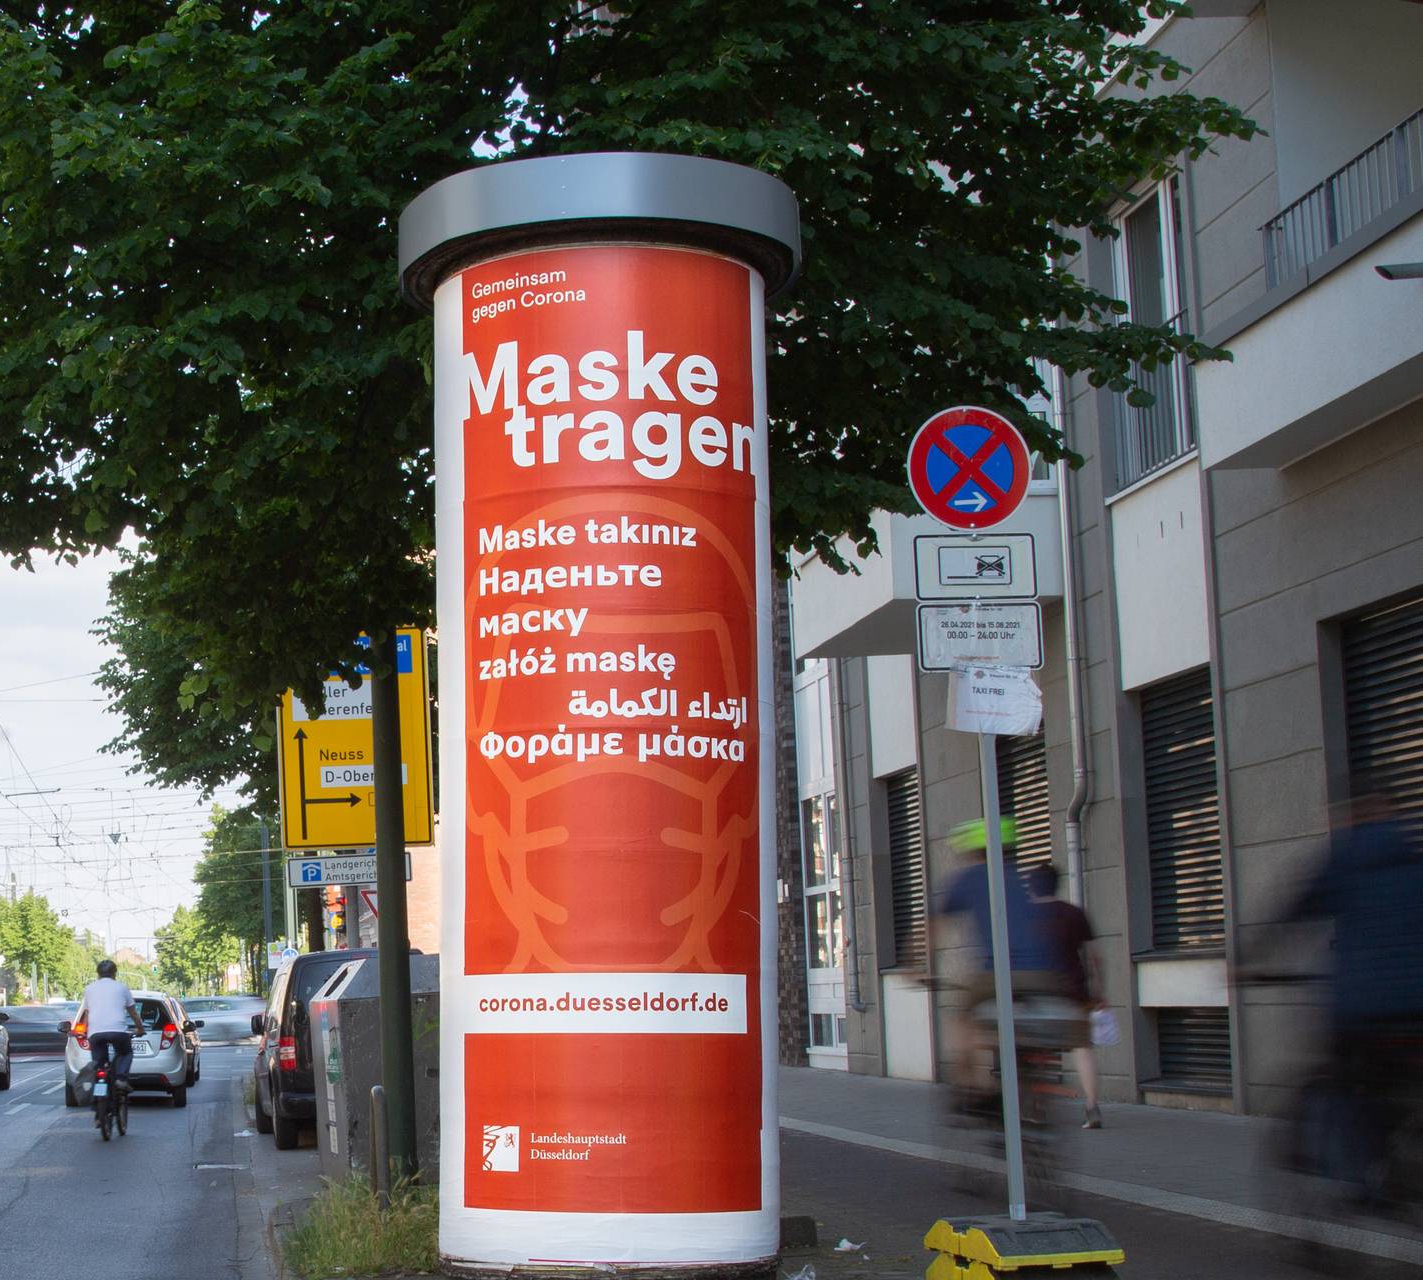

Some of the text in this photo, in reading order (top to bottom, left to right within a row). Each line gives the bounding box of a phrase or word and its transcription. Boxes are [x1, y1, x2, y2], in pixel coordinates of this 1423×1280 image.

[472, 269, 566, 300] Gemeinsam
[472, 287, 586, 323] gegen Corona
[462, 330, 718, 420] Maske
[504, 403, 757, 480] tragen
[479, 519, 576, 555] Maske
[479, 564, 662, 597] Наденьте
[479, 607, 589, 638] маску
[1000, 631, 1016, 640] Uhr
[479, 644, 676, 681] załóż maskę
[328, 686, 348, 698] ler
[972, 686, 1005, 696] TAXI FREI
[327, 702, 374, 716] erenfe
[568, 687, 747, 730] ارتداء الكمامة
[479, 724, 745, 763] Φοράμε μάσκα
[319, 748, 364, 762] Neuss
[325, 769, 374, 784] D-Ober
[324, 858, 377, 871] Landgerich
[325, 869, 377, 882] Amtsgerich
[479, 991, 729, 1013] corona.duesseldorf.de
[530, 1132, 627, 1147] Landeshauptstadt
[530, 1148, 591, 1161] Düsseldorf
